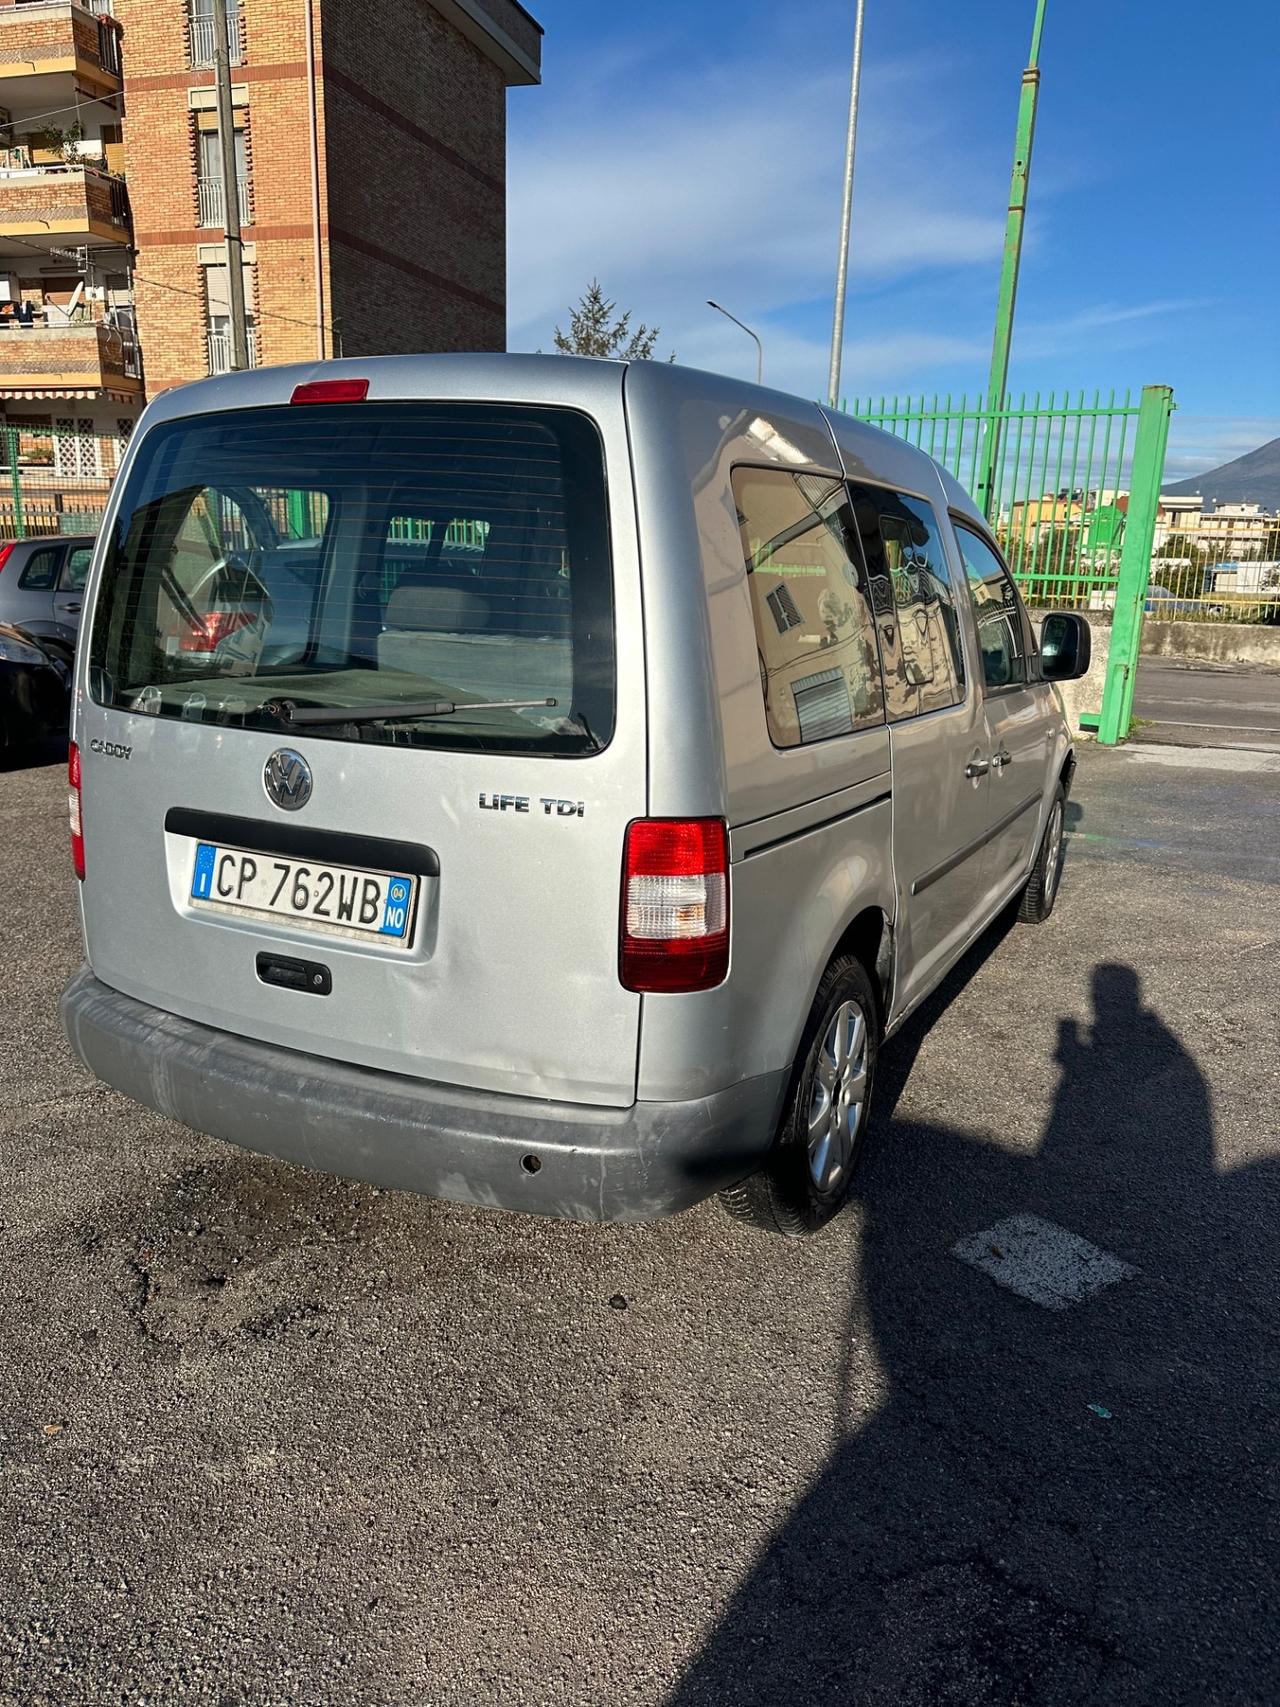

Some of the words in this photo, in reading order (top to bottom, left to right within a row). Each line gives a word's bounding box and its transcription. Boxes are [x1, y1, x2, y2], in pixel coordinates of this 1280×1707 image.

[91, 739, 132, 760] CADDY
[479, 793, 529, 812] LIFE
[216, 854, 257, 899] CP
[385, 906, 404, 928] NO
